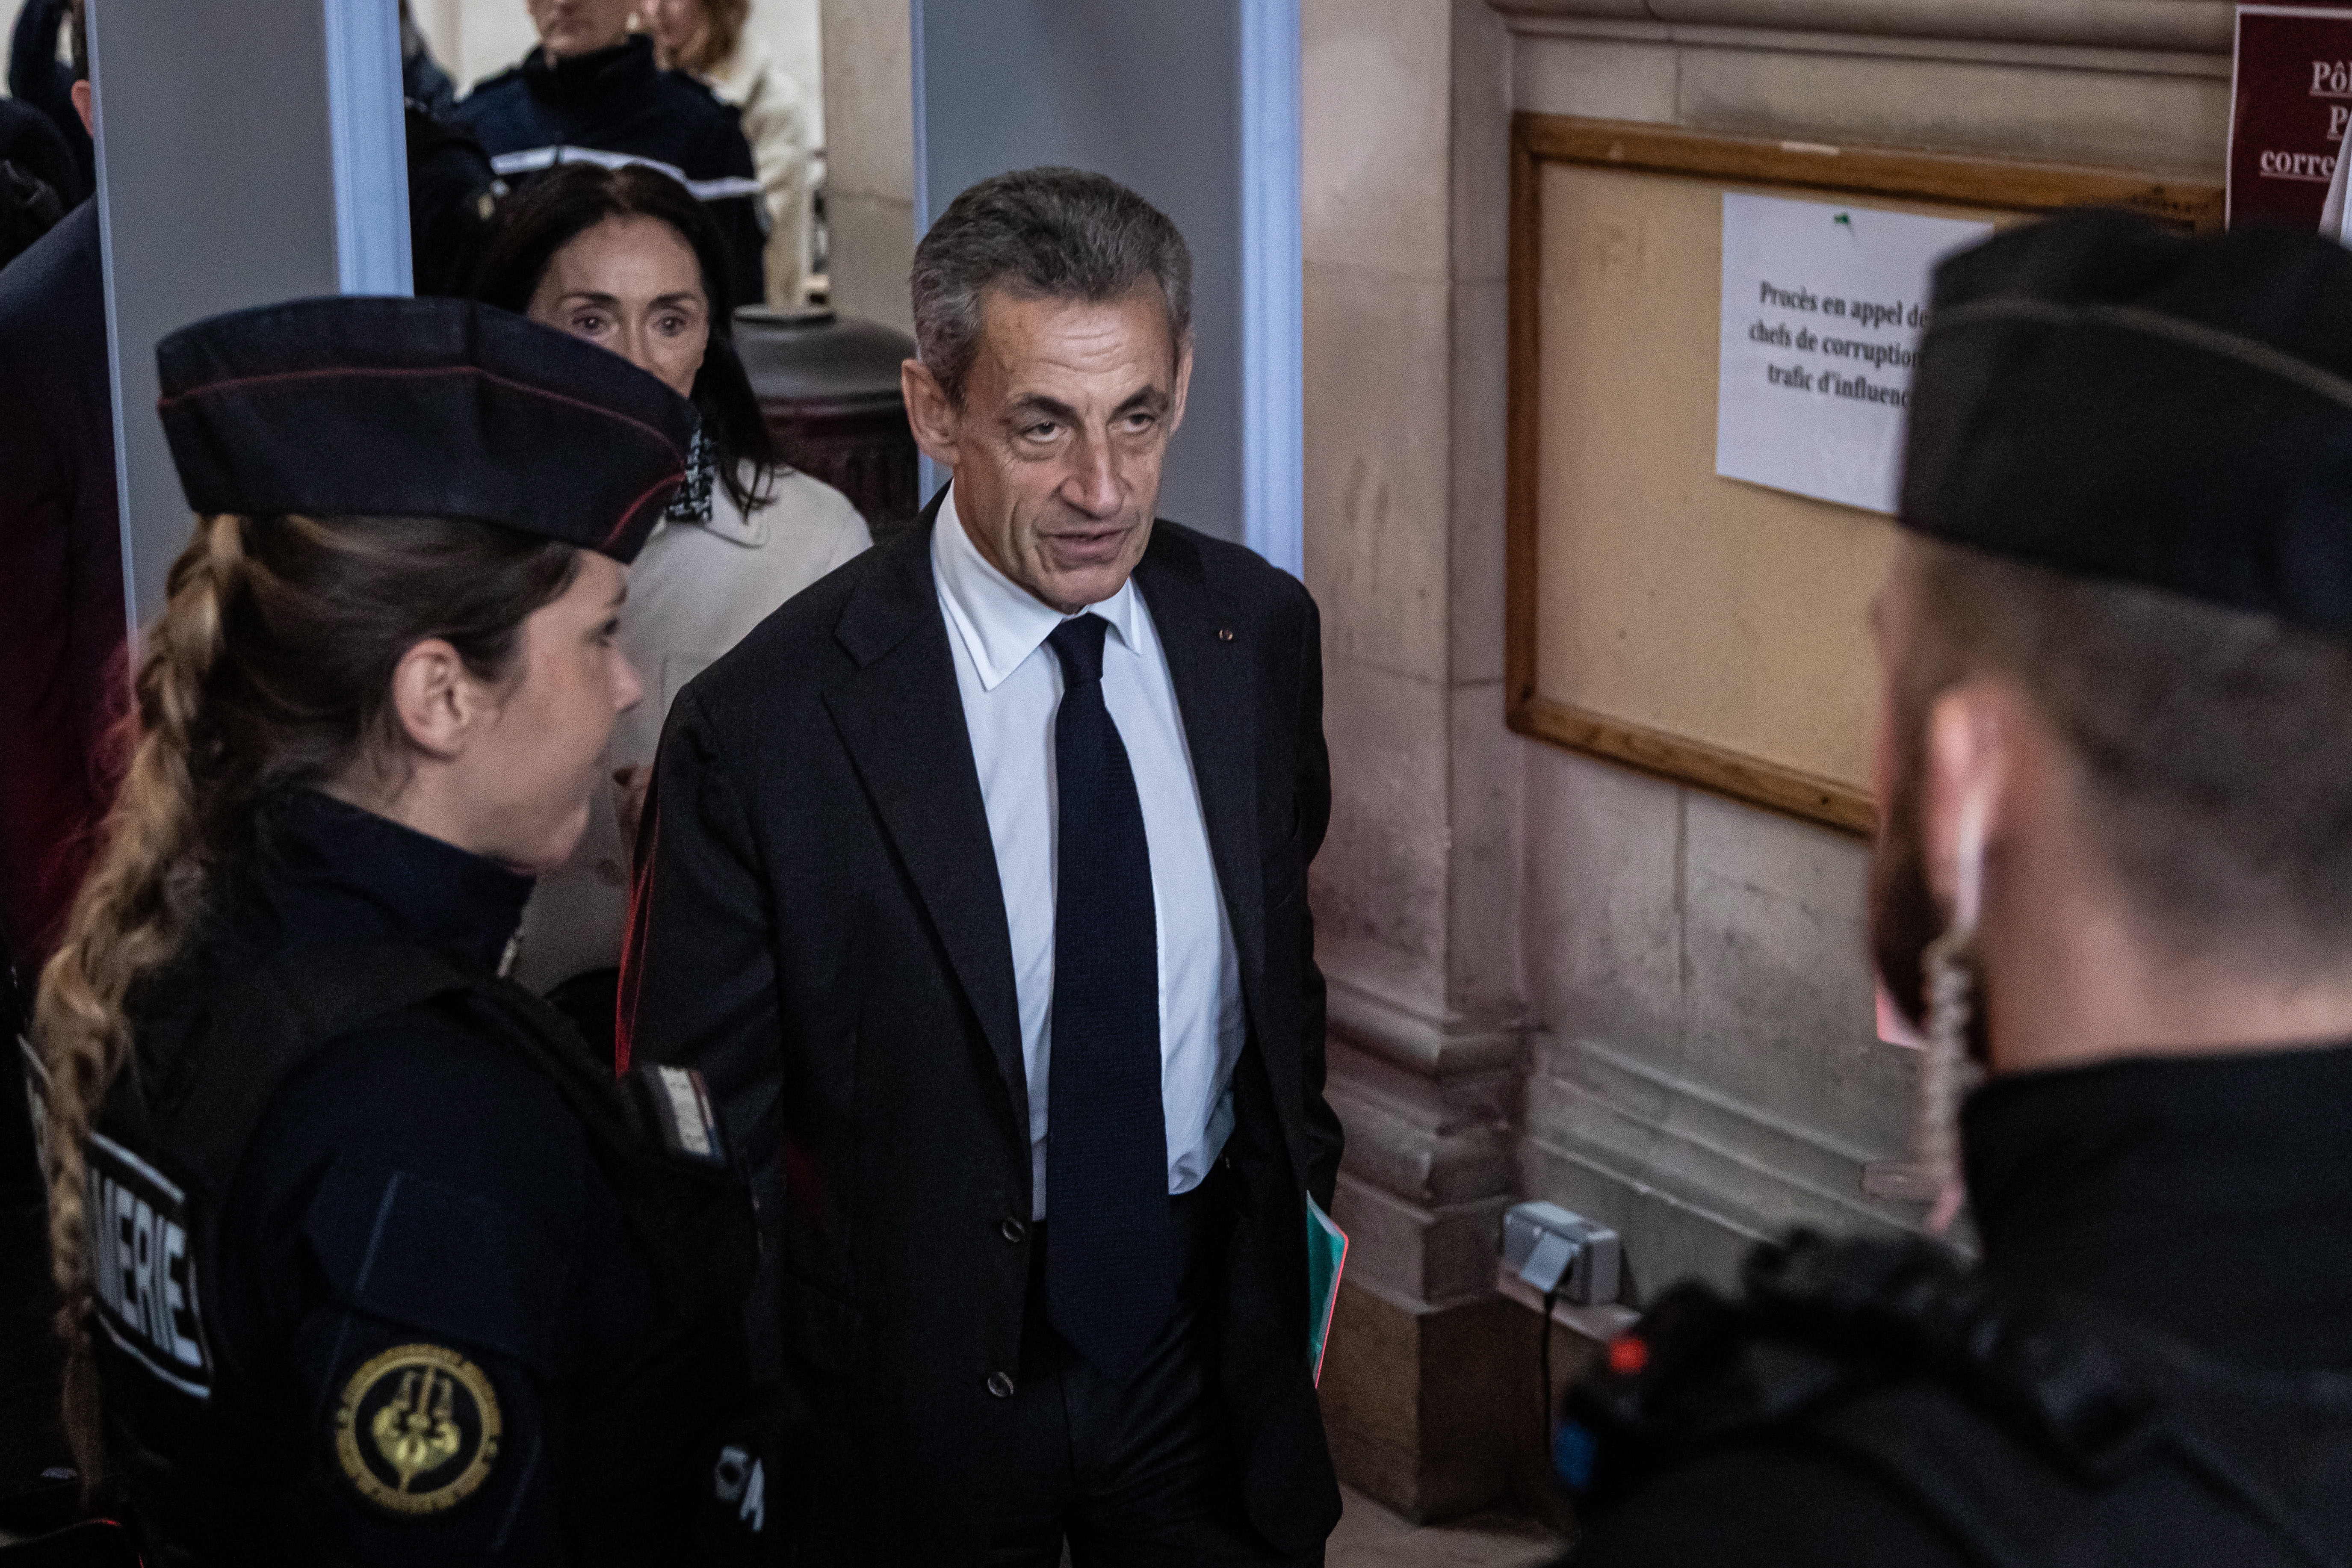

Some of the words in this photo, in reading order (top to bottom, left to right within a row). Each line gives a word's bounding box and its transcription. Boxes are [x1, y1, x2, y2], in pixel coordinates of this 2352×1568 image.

[1759, 281, 1817, 311] Procès
[1823, 298, 1846, 316] en
[1851, 301, 1903, 329] appel
[1749, 320, 1791, 347] chefs
[1797, 327, 1817, 351] de
[1768, 364, 1813, 392] trafic
